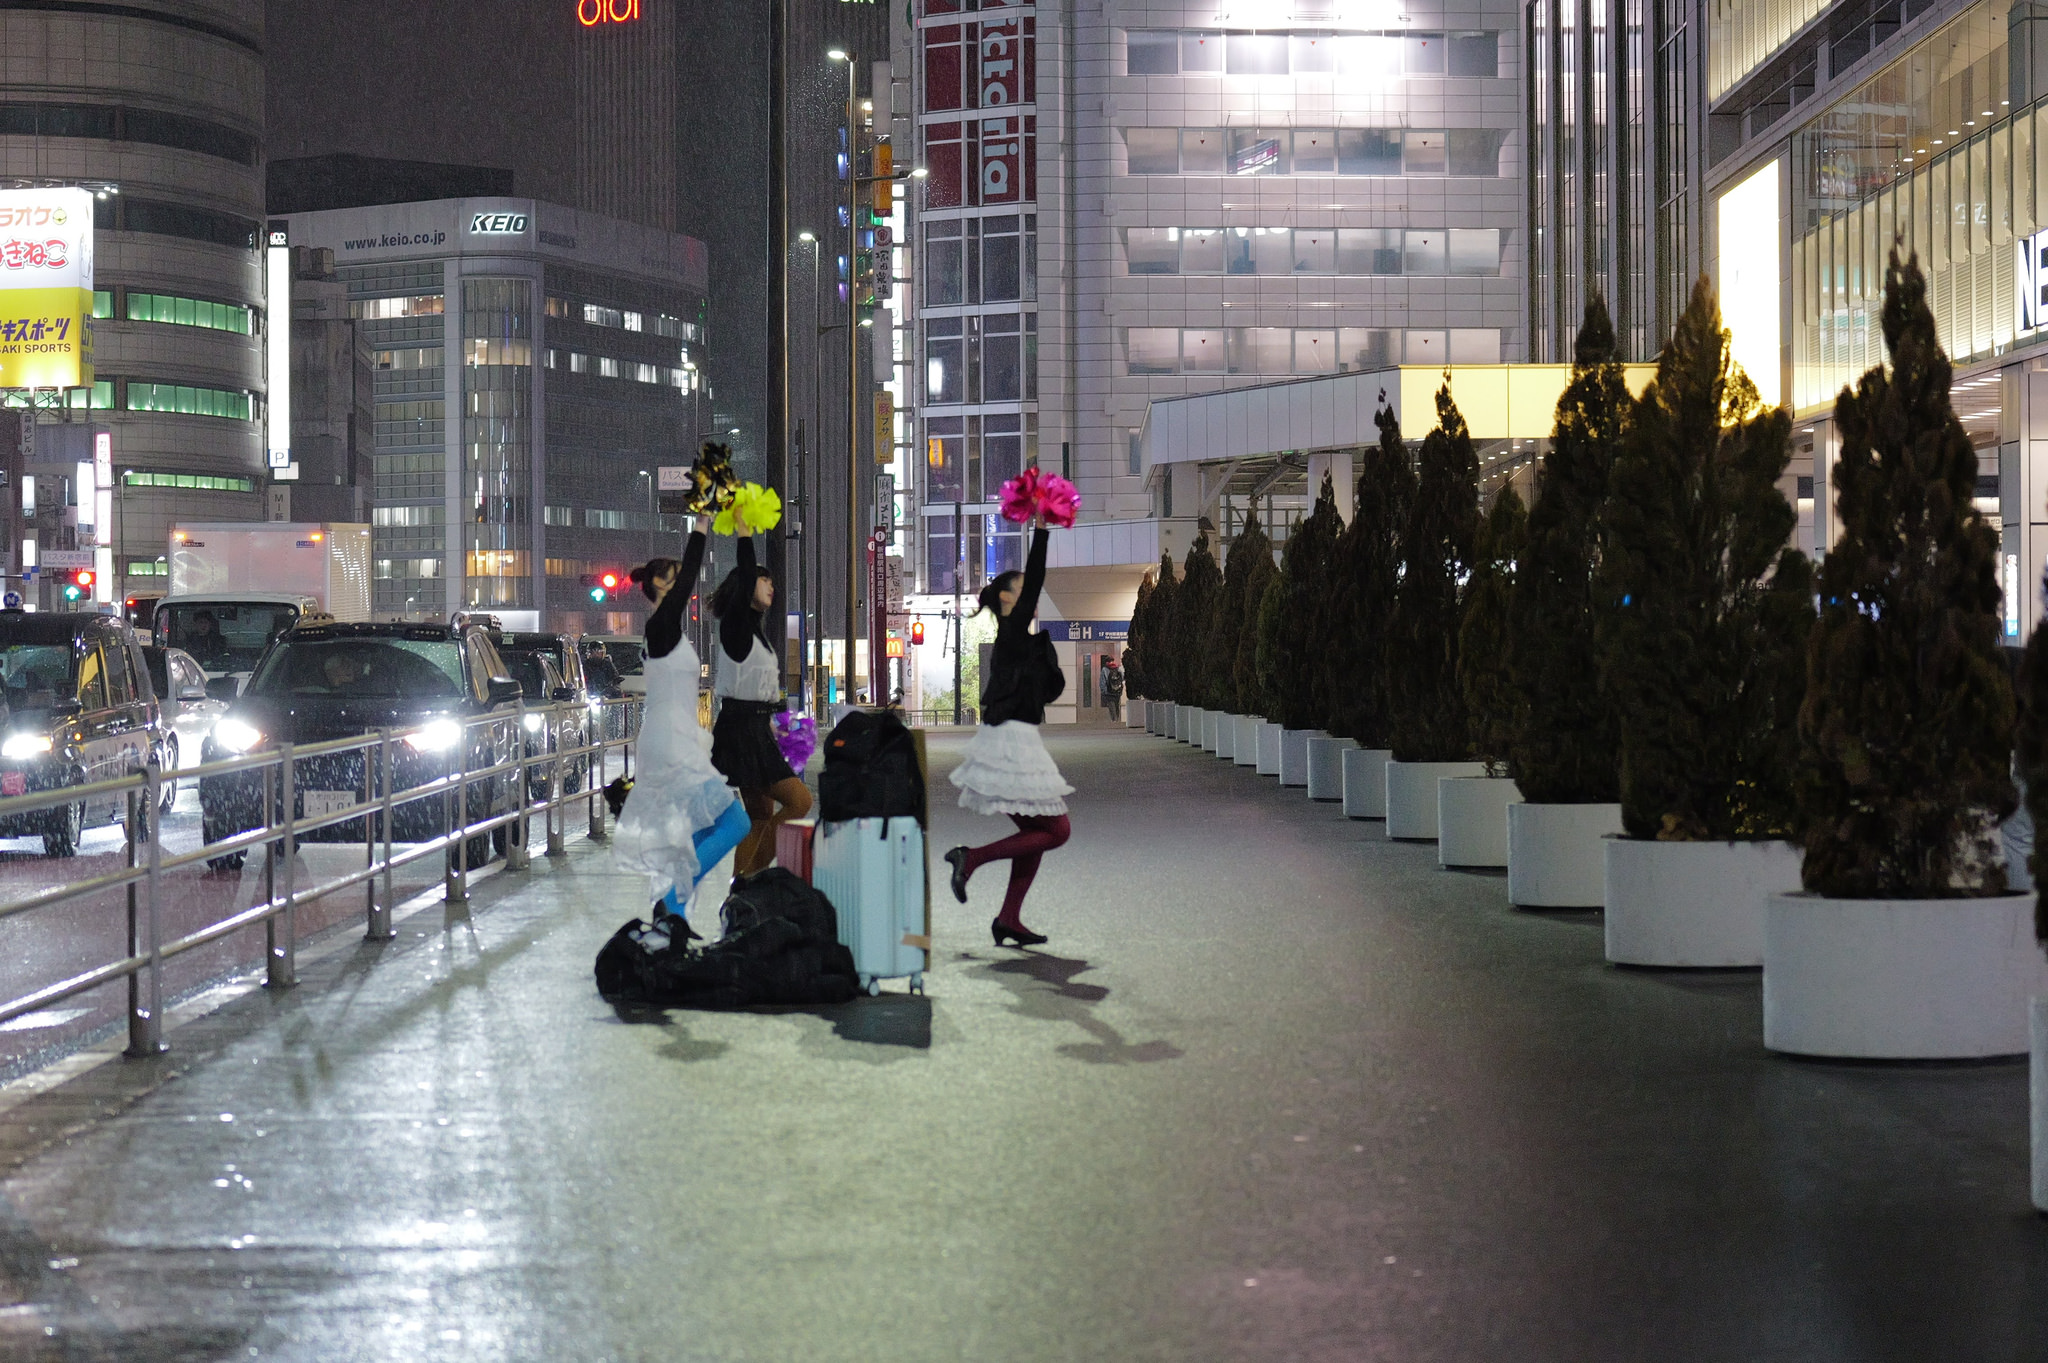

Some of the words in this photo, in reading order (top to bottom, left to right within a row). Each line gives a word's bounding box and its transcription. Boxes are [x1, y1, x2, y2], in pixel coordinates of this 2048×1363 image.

[983, 0, 1018, 195] ictoria
[471, 214, 528, 233] KEIO
[345, 230, 446, 250] www.keio.co.jp
[0, 238, 67, 267] きねこ
[0, 317, 71, 342] キスポーツ
[24, 343, 71, 353] SPORTS
[275, 452, 285, 464] P
[1083, 627, 1092, 639] H
